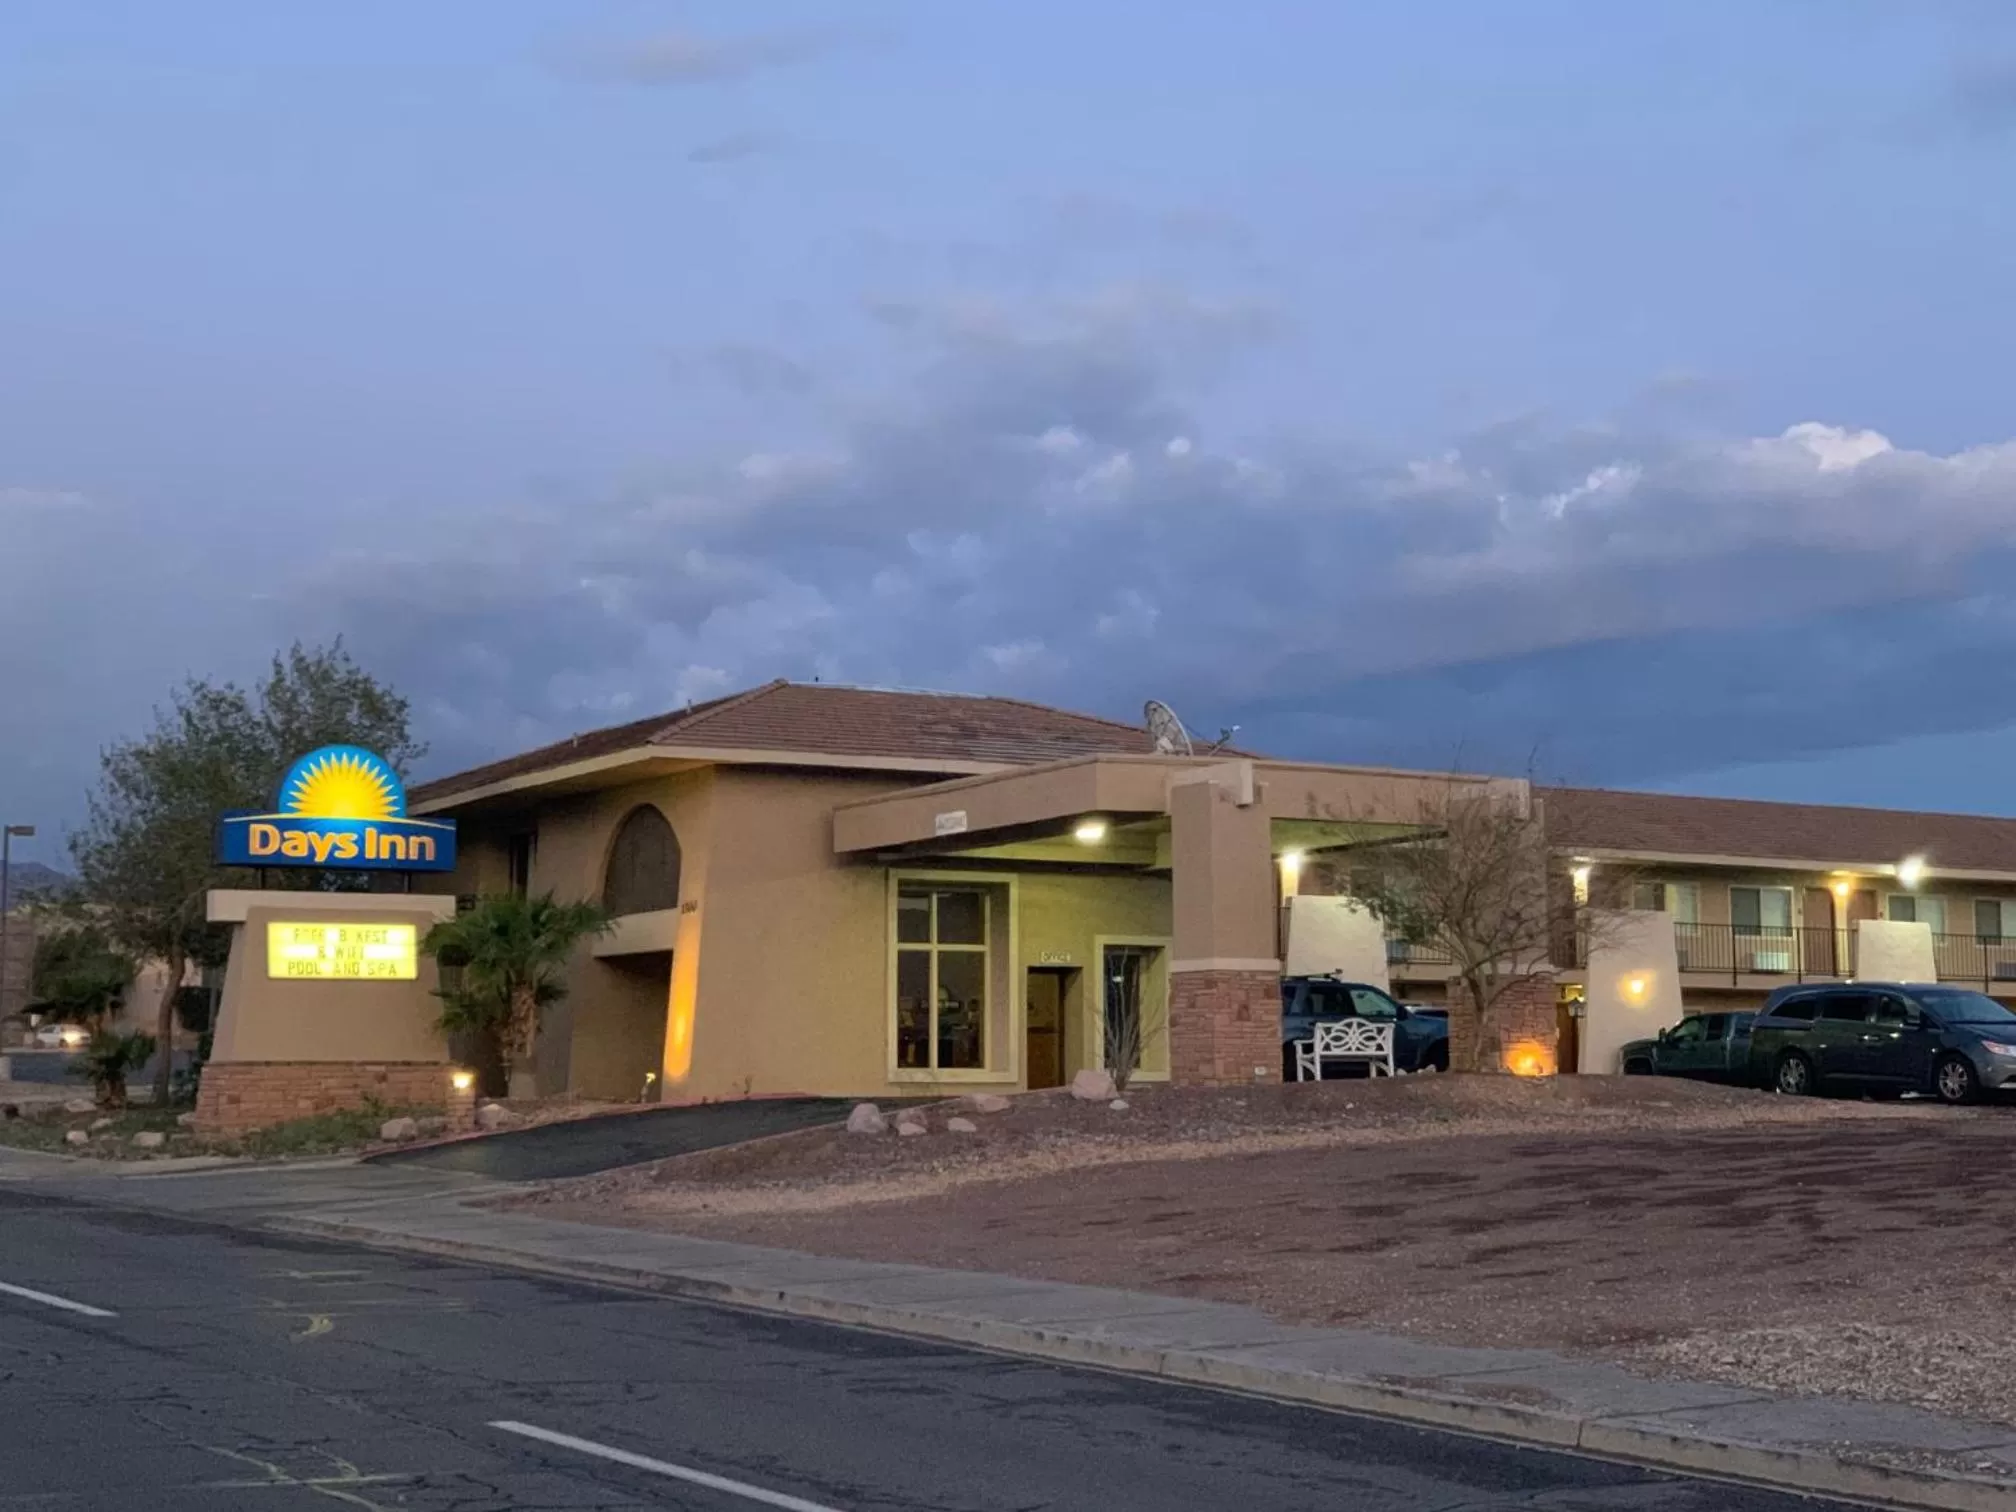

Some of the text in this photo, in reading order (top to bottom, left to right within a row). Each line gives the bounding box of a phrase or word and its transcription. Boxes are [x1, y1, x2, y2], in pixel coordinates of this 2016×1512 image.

[249, 823, 435, 862] Days Inn
[287, 960, 321, 975] POOL
[367, 961, 397, 976] SPA
